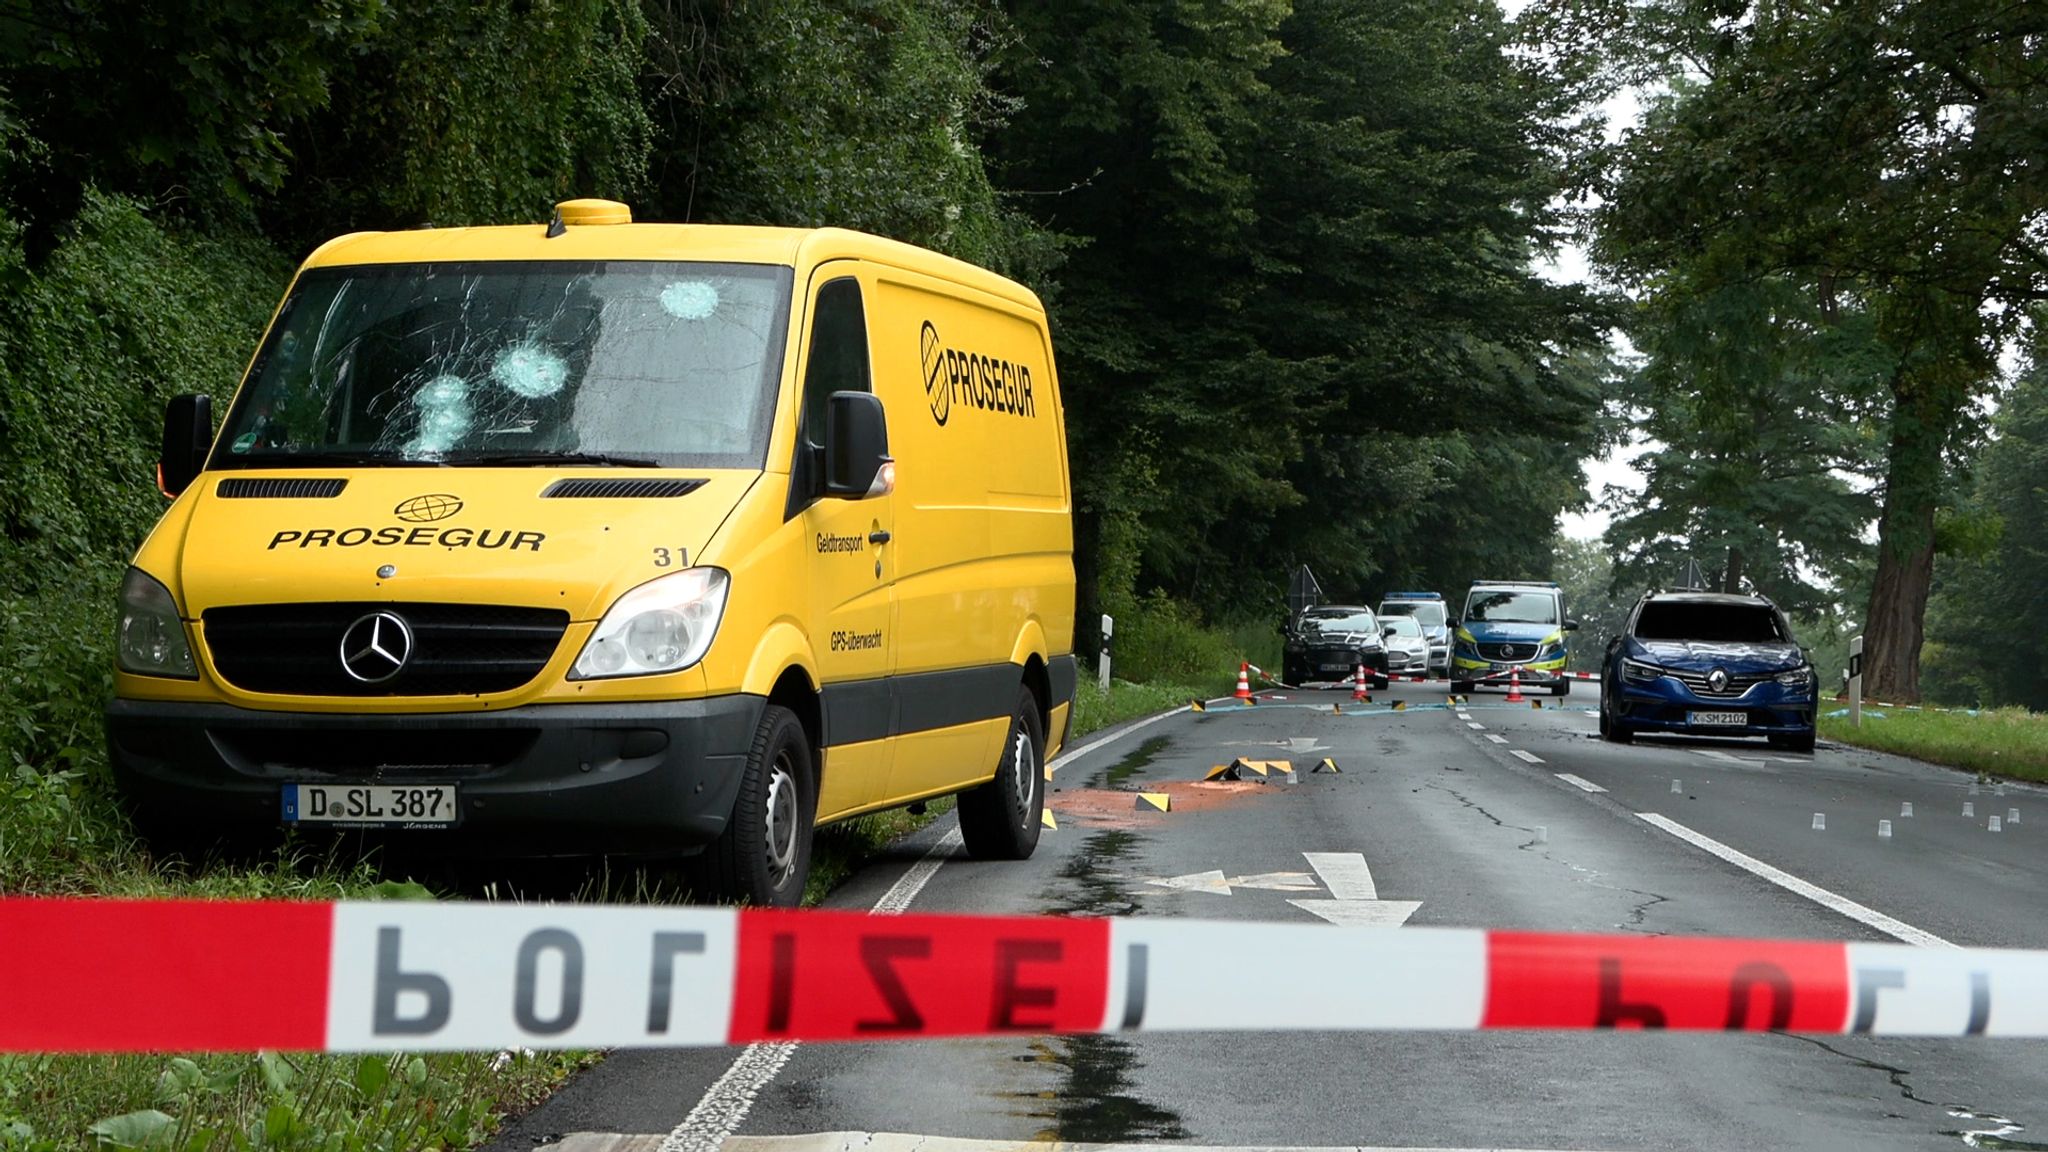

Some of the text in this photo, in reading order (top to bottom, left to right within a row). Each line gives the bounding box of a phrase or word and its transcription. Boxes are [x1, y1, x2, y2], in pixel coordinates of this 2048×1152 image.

[946, 348, 1035, 418] PROSEGUR
[267, 527, 546, 551] PROSEGUR
[816, 532, 863, 556] Geldtransport
[653, 547, 688, 567] 31
[831, 629, 882, 652] GPS-überwacht
[1693, 713, 1700, 723] K
[1721, 714, 1746, 724] 2102
[309, 788, 444, 817] D SL 387
